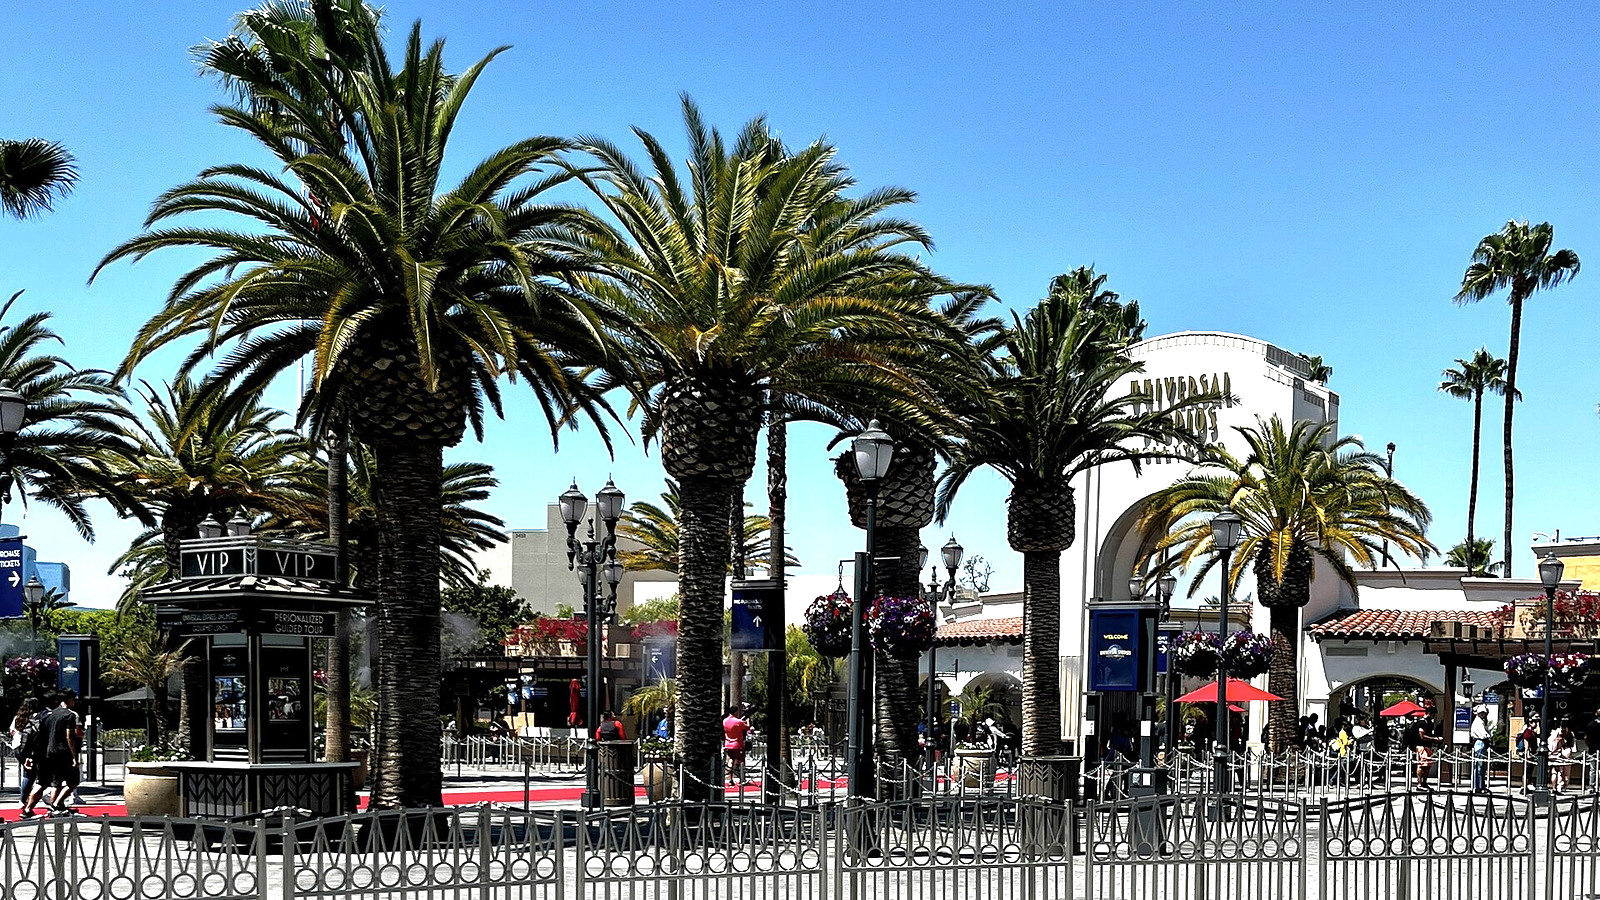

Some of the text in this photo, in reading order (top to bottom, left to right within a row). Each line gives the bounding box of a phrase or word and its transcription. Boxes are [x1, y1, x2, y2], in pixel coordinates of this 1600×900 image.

[197, 551, 229, 575] VIP
[275, 552, 315, 577] VIP
[274, 612, 324, 624] PERSONALIZED
[275, 623, 324, 634] GUIDED TOUR
[1555, 701, 1568, 710] 10
